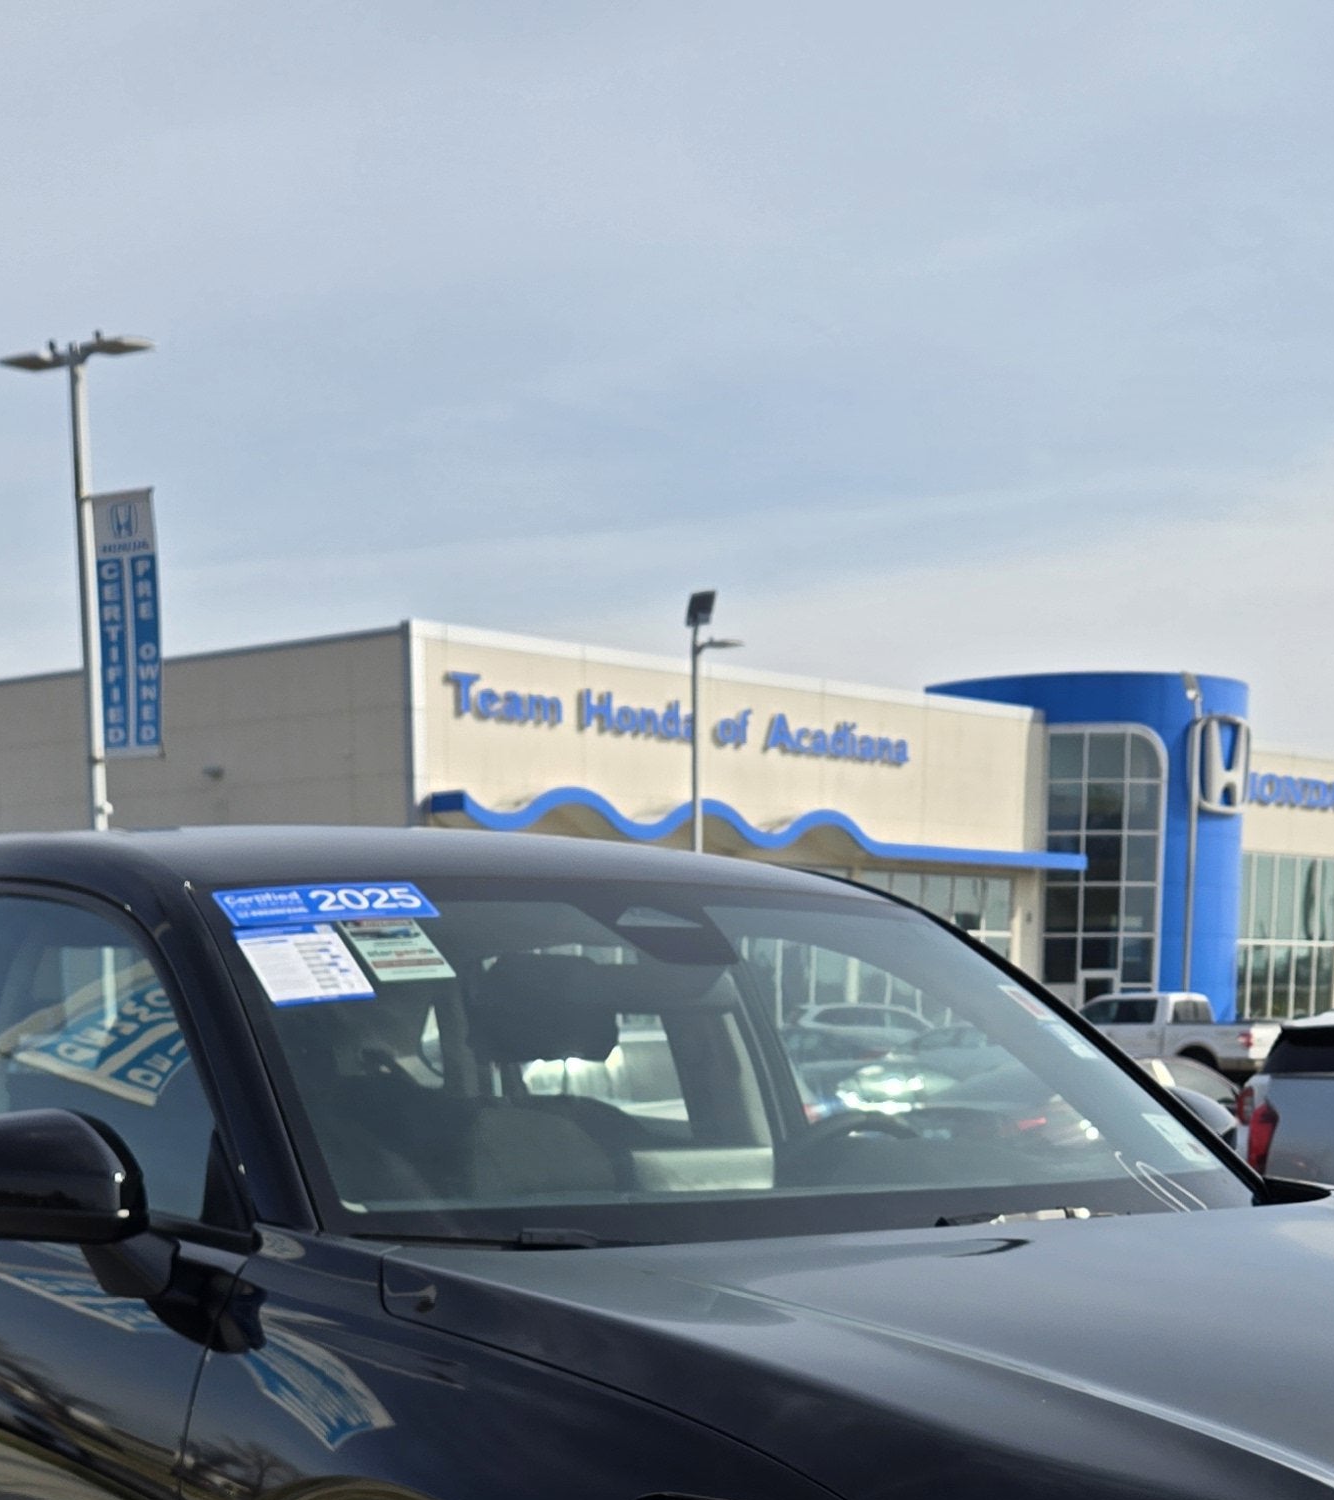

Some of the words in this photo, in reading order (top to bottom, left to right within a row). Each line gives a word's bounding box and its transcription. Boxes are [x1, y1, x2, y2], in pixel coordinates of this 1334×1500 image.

[100, 562, 126, 745] CERTIFIED
[137, 642, 159, 742] OWNED
[449, 671, 563, 724] Team
[717, 708, 753, 745] of
[767, 713, 910, 766] Acadiana
[308, 887, 422, 912] 2025
